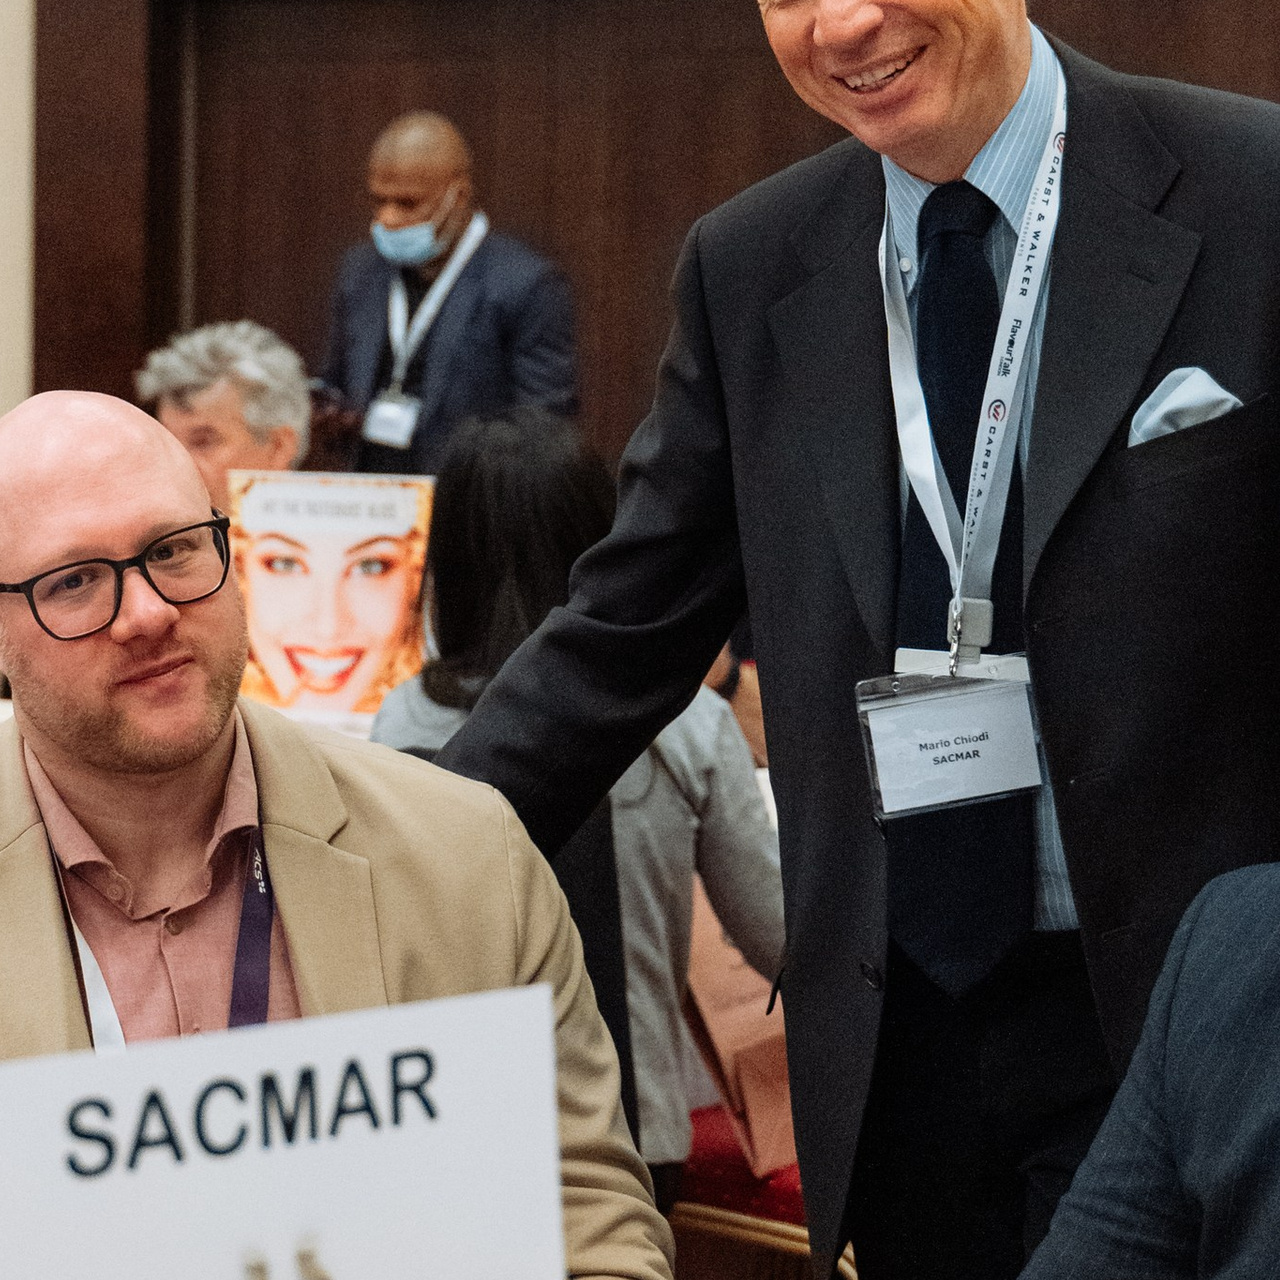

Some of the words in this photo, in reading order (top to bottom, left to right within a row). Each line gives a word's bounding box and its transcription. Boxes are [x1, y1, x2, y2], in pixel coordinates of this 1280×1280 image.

[1042, 156, 1060, 206] CARST
[1019, 230, 1042, 298] WALKER
[980, 425, 997, 481] CARST
[918, 739, 951, 751] Mario
[953, 731, 990, 746] Chiodi
[932, 749, 981, 765] SACMAR
[253, 847, 263, 881] ACS
[66, 1048, 439, 1179] SACMAR
